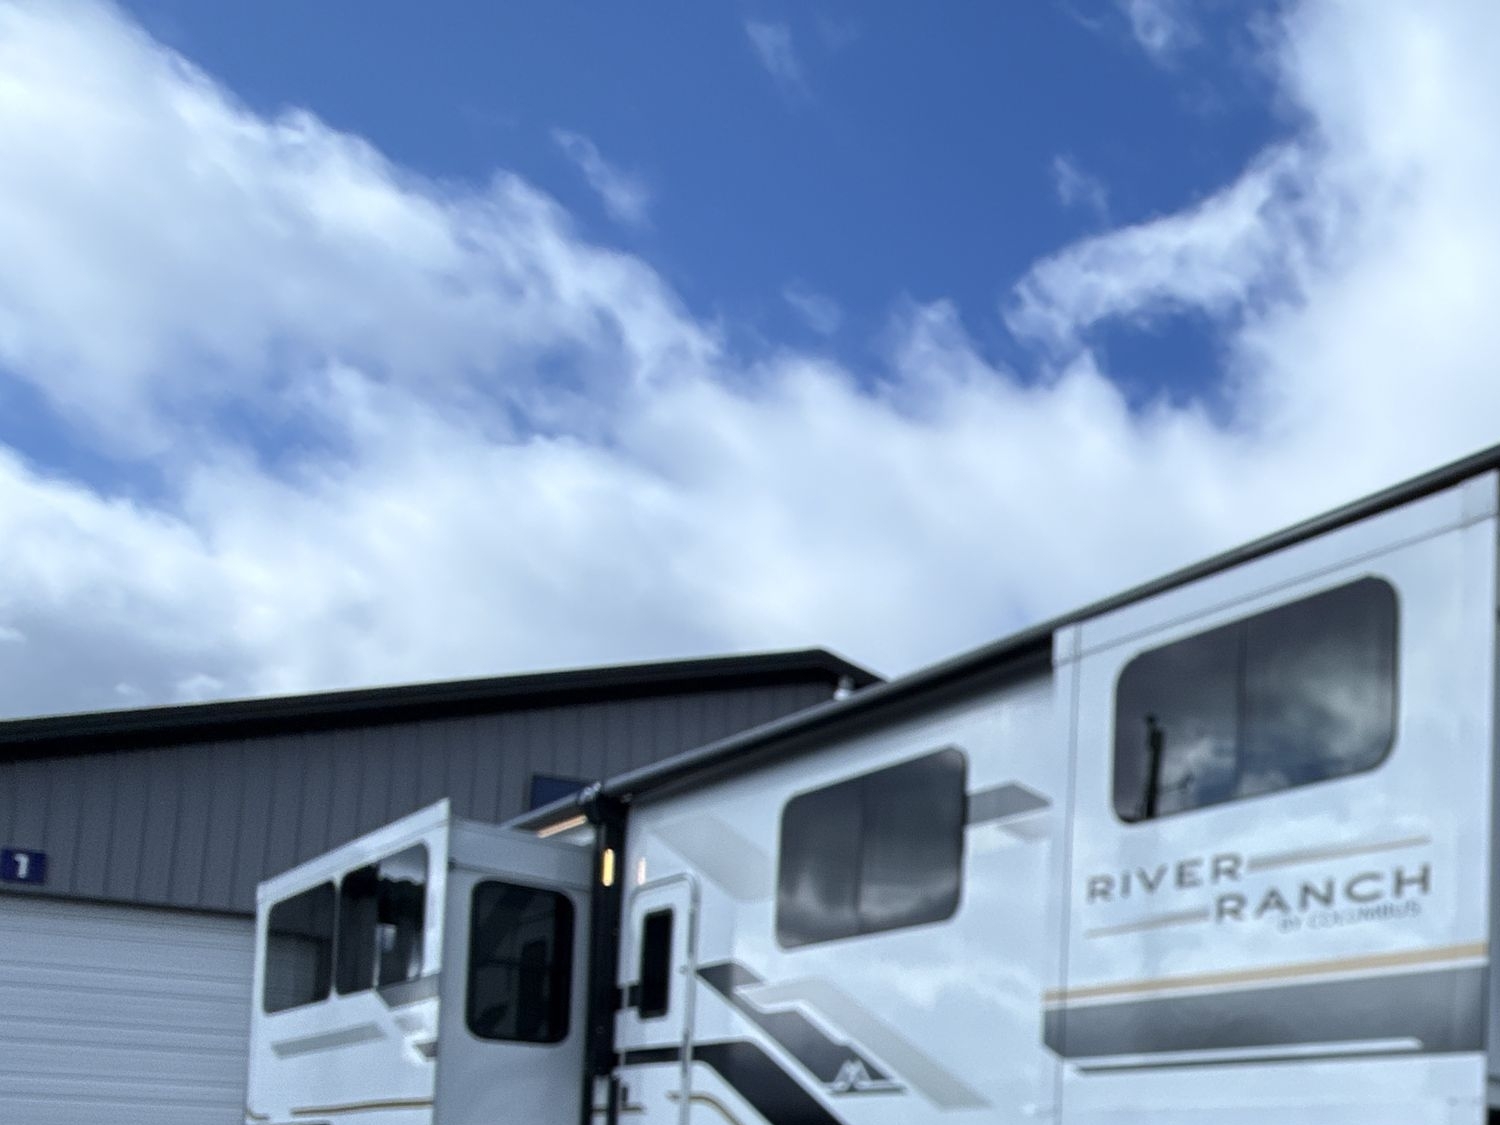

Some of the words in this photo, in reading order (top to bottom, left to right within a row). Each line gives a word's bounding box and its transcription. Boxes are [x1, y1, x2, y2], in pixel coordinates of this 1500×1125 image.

[14, 852, 30, 879] 1
[1087, 853, 1244, 902] RIVER
[1215, 864, 1430, 921] RANCH
